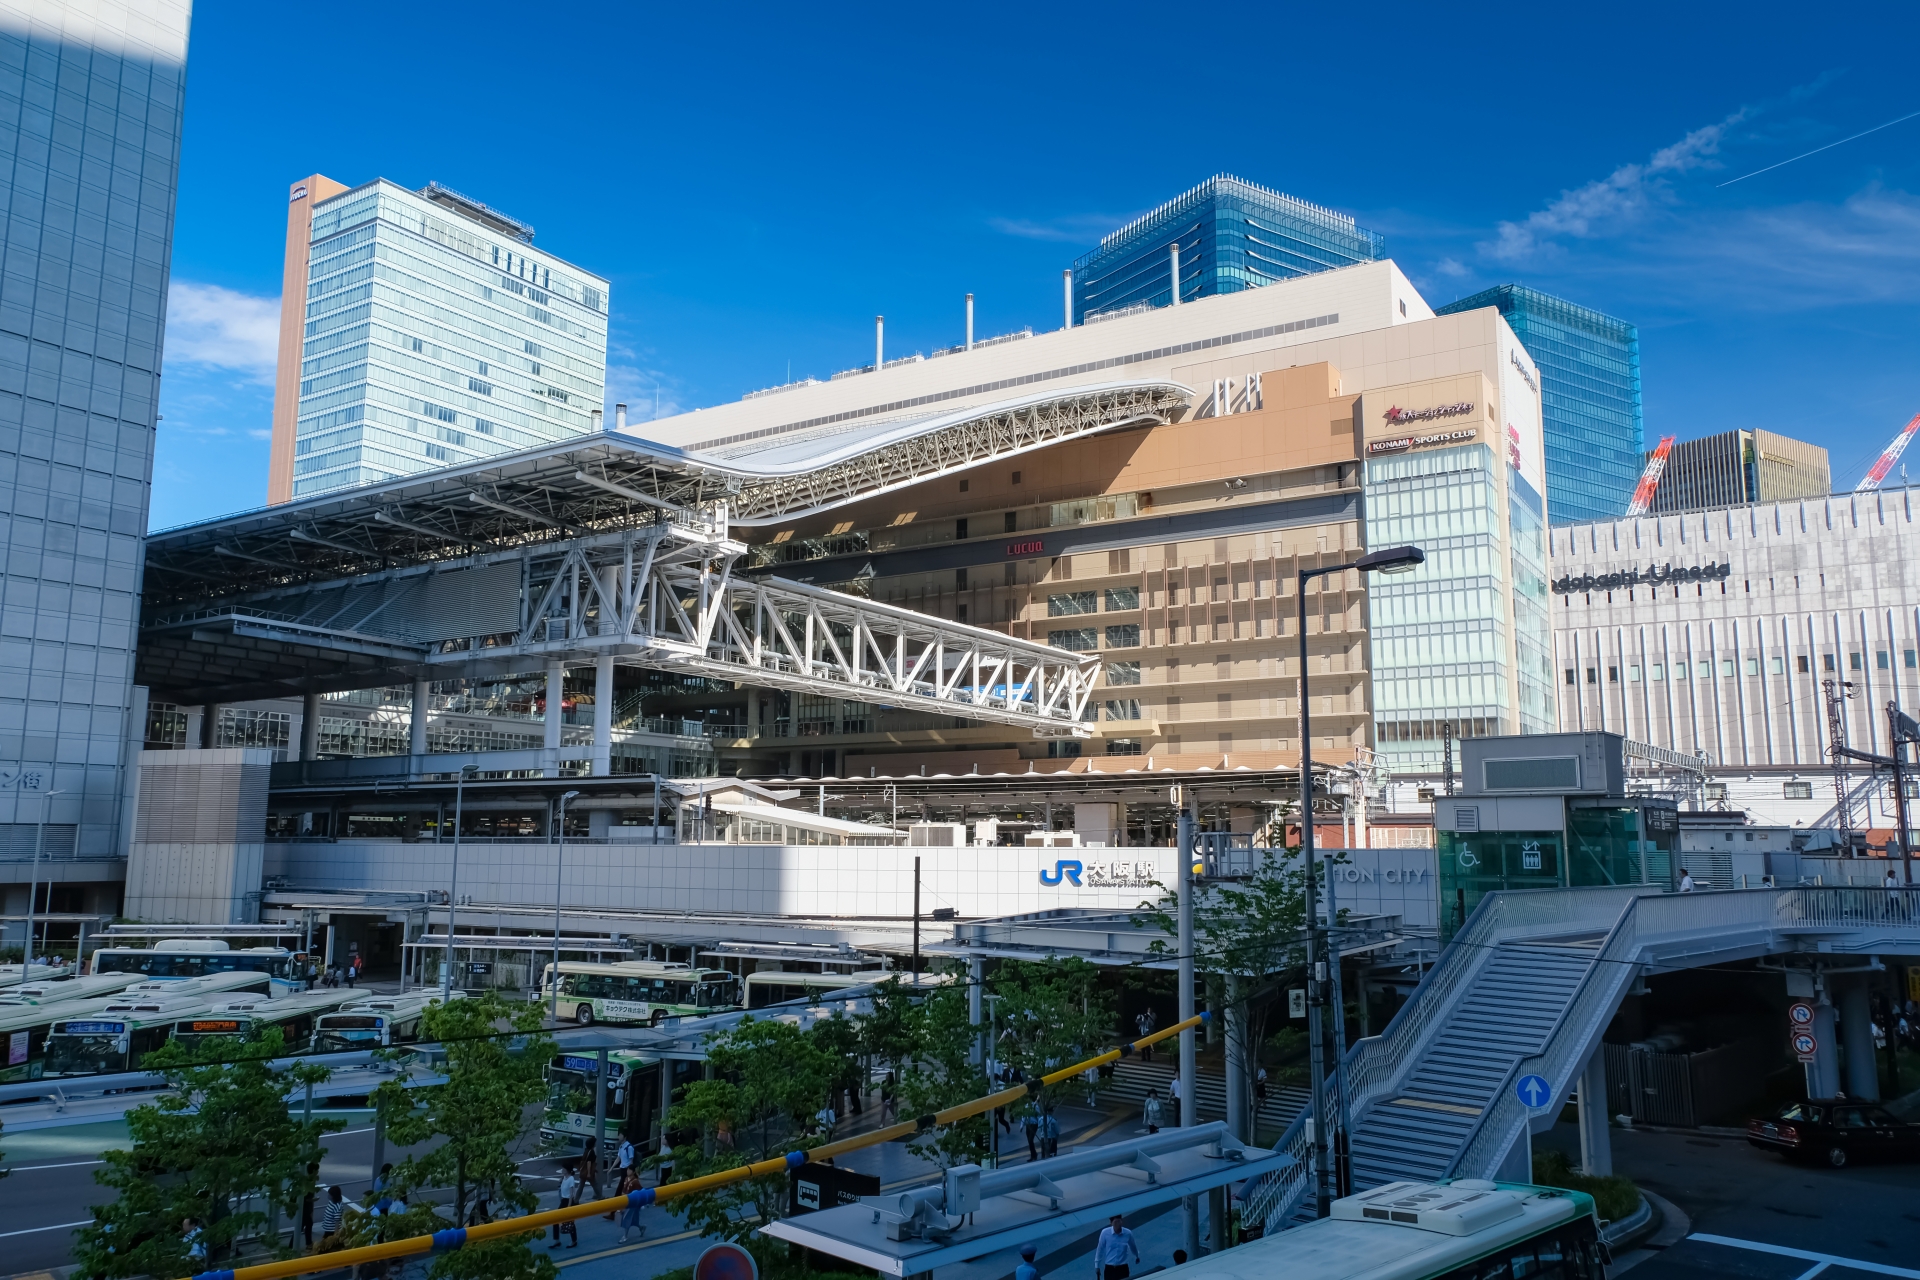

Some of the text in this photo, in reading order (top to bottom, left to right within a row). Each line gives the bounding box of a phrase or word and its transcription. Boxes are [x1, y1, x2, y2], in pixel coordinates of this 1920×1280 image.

[1372, 428, 1477, 451] KONAMI SPORTS CLUB
[1040, 859, 1083, 888] JR
[1087, 859, 1155, 879] 大阪駅
[1383, 867, 1428, 884] CITY
[1089, 877, 1153, 887] OSAKA STATIO
[565, 1057, 576, 1068] 59
